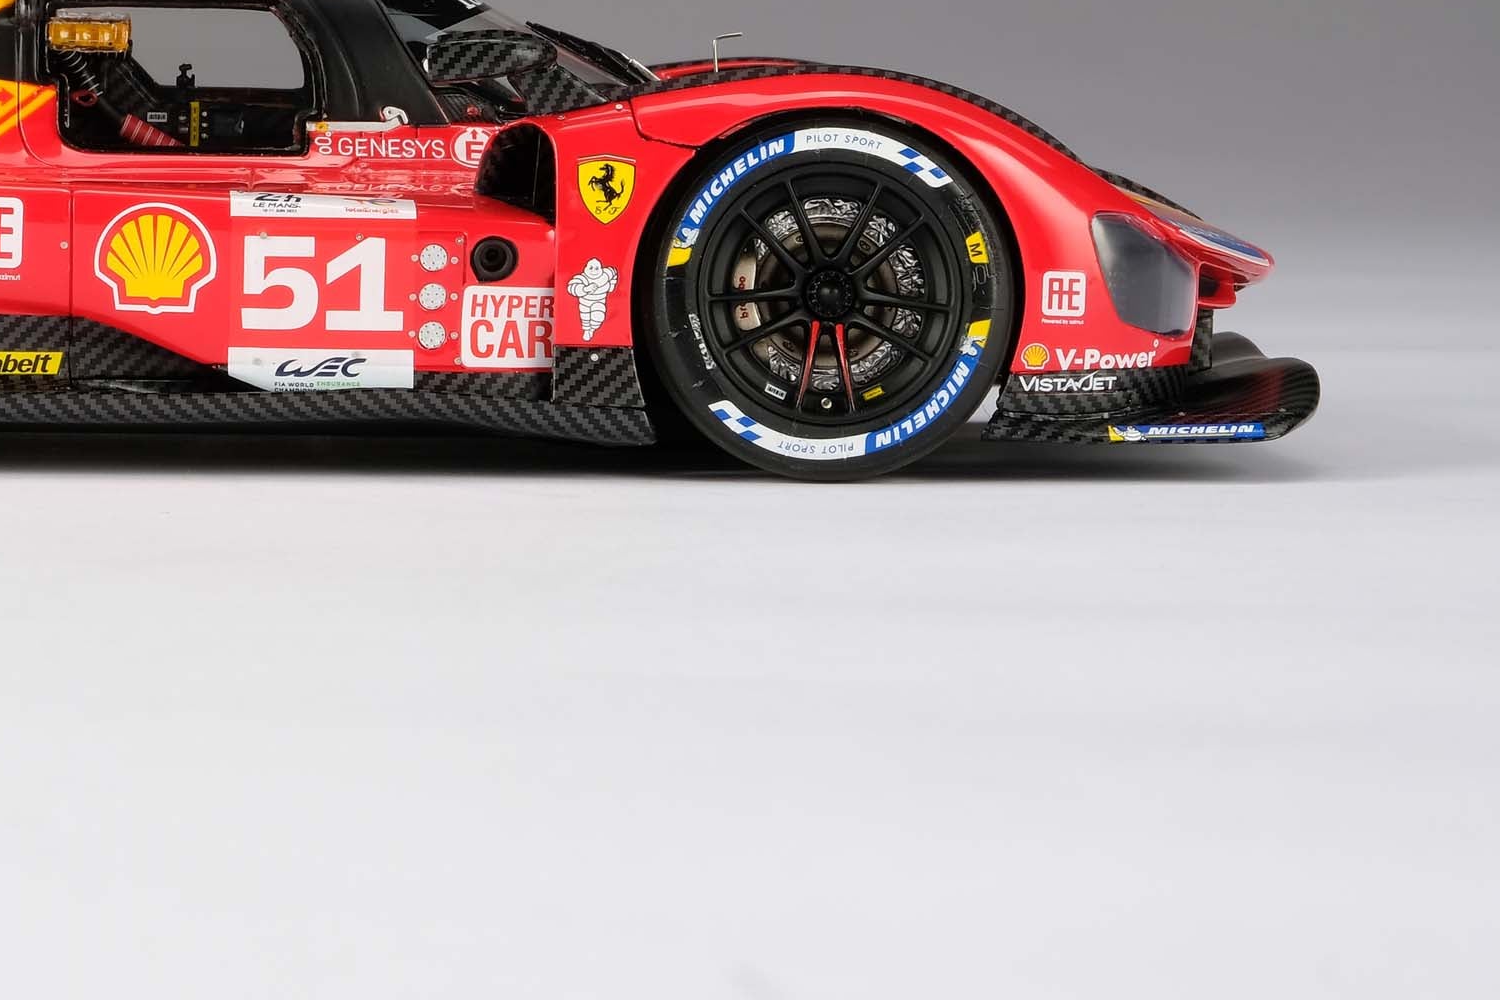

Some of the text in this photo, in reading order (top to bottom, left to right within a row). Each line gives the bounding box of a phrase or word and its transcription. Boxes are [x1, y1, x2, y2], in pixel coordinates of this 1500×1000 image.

[338, 137, 445, 159] GENESYS
[806, 134, 883, 150] PILOT SPORT
[689, 140, 785, 222] MICHELIN
[969, 243, 983, 257] M
[241, 235, 404, 332] 51
[471, 294, 554, 318] HYPER
[470, 320, 553, 358] CAR
[275, 357, 367, 378] WEC
[1055, 348, 1156, 370] V-Power
[876, 362, 971, 449] MICHELIN
[1147, 424, 1256, 435] MICHELIN
[778, 441, 855, 455] PILOT SPORT
